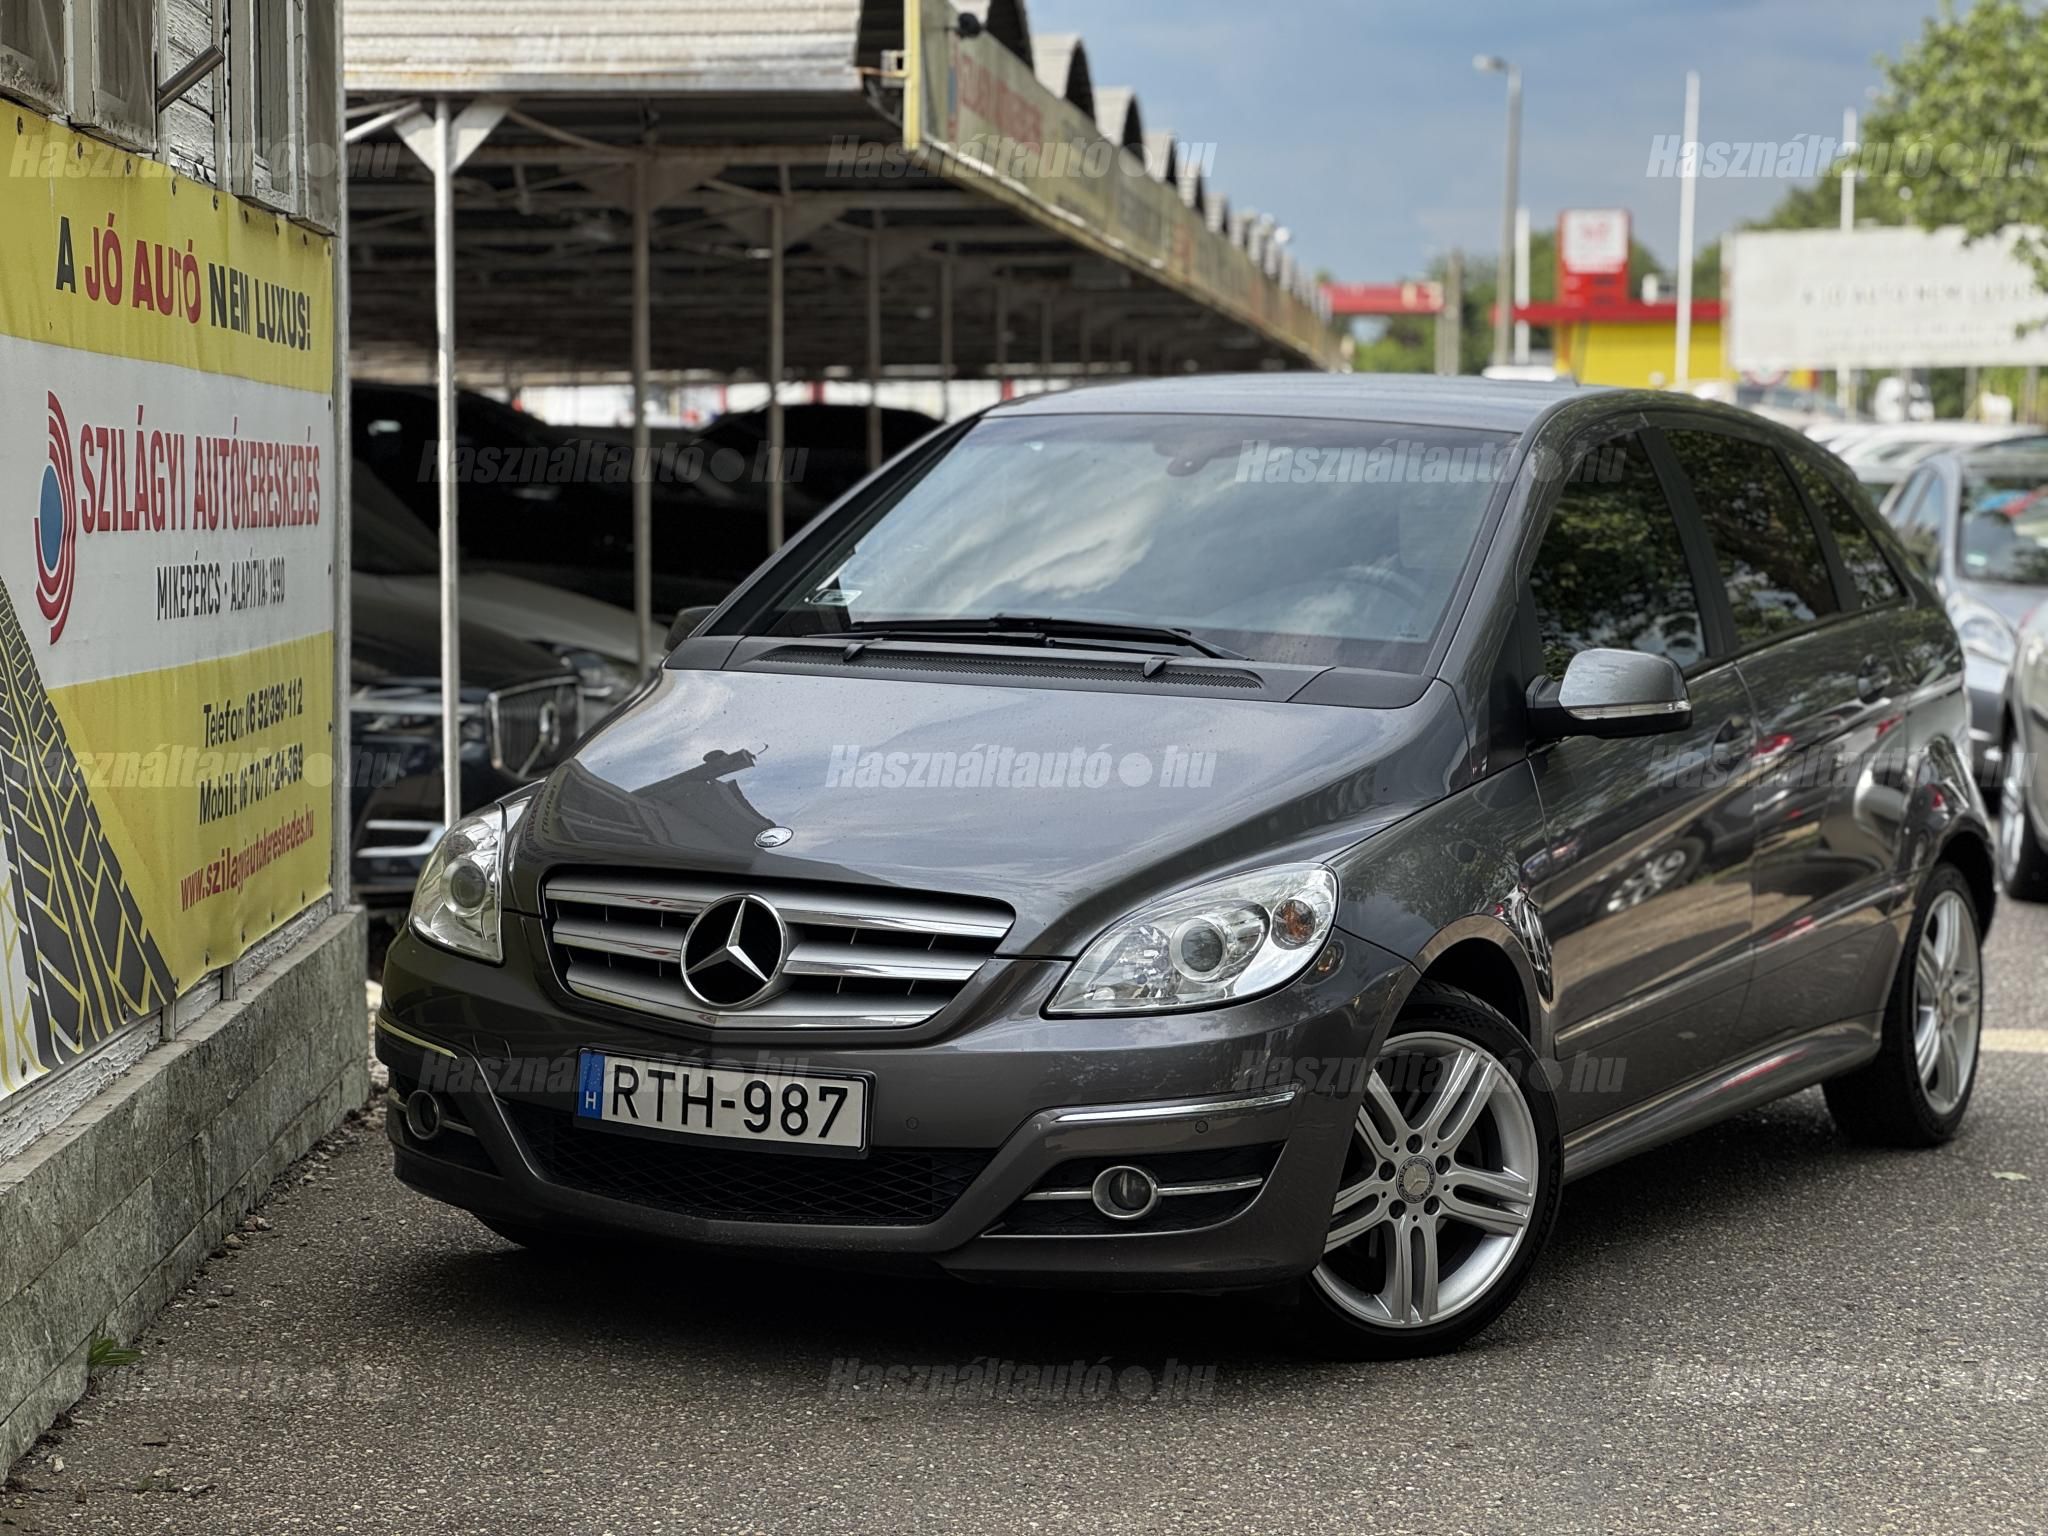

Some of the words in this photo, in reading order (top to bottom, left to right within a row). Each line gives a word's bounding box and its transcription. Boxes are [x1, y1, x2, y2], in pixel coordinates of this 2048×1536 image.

[55, 216, 77, 294] A
[84, 212, 124, 305] JÓ
[132, 239, 202, 325] AUTÓ
[208, 262, 250, 336] NEM
[254, 278, 312, 351] LUXUS!
[80, 404, 187, 535] SZILÁGYI
[193, 416, 321, 532] AUTÓKERESKEDÉS
[157, 550, 221, 621] MIKEPÉRCS
[199, 771, 238, 826] Mobil:
[611, 1063, 849, 1139] RTH-987
